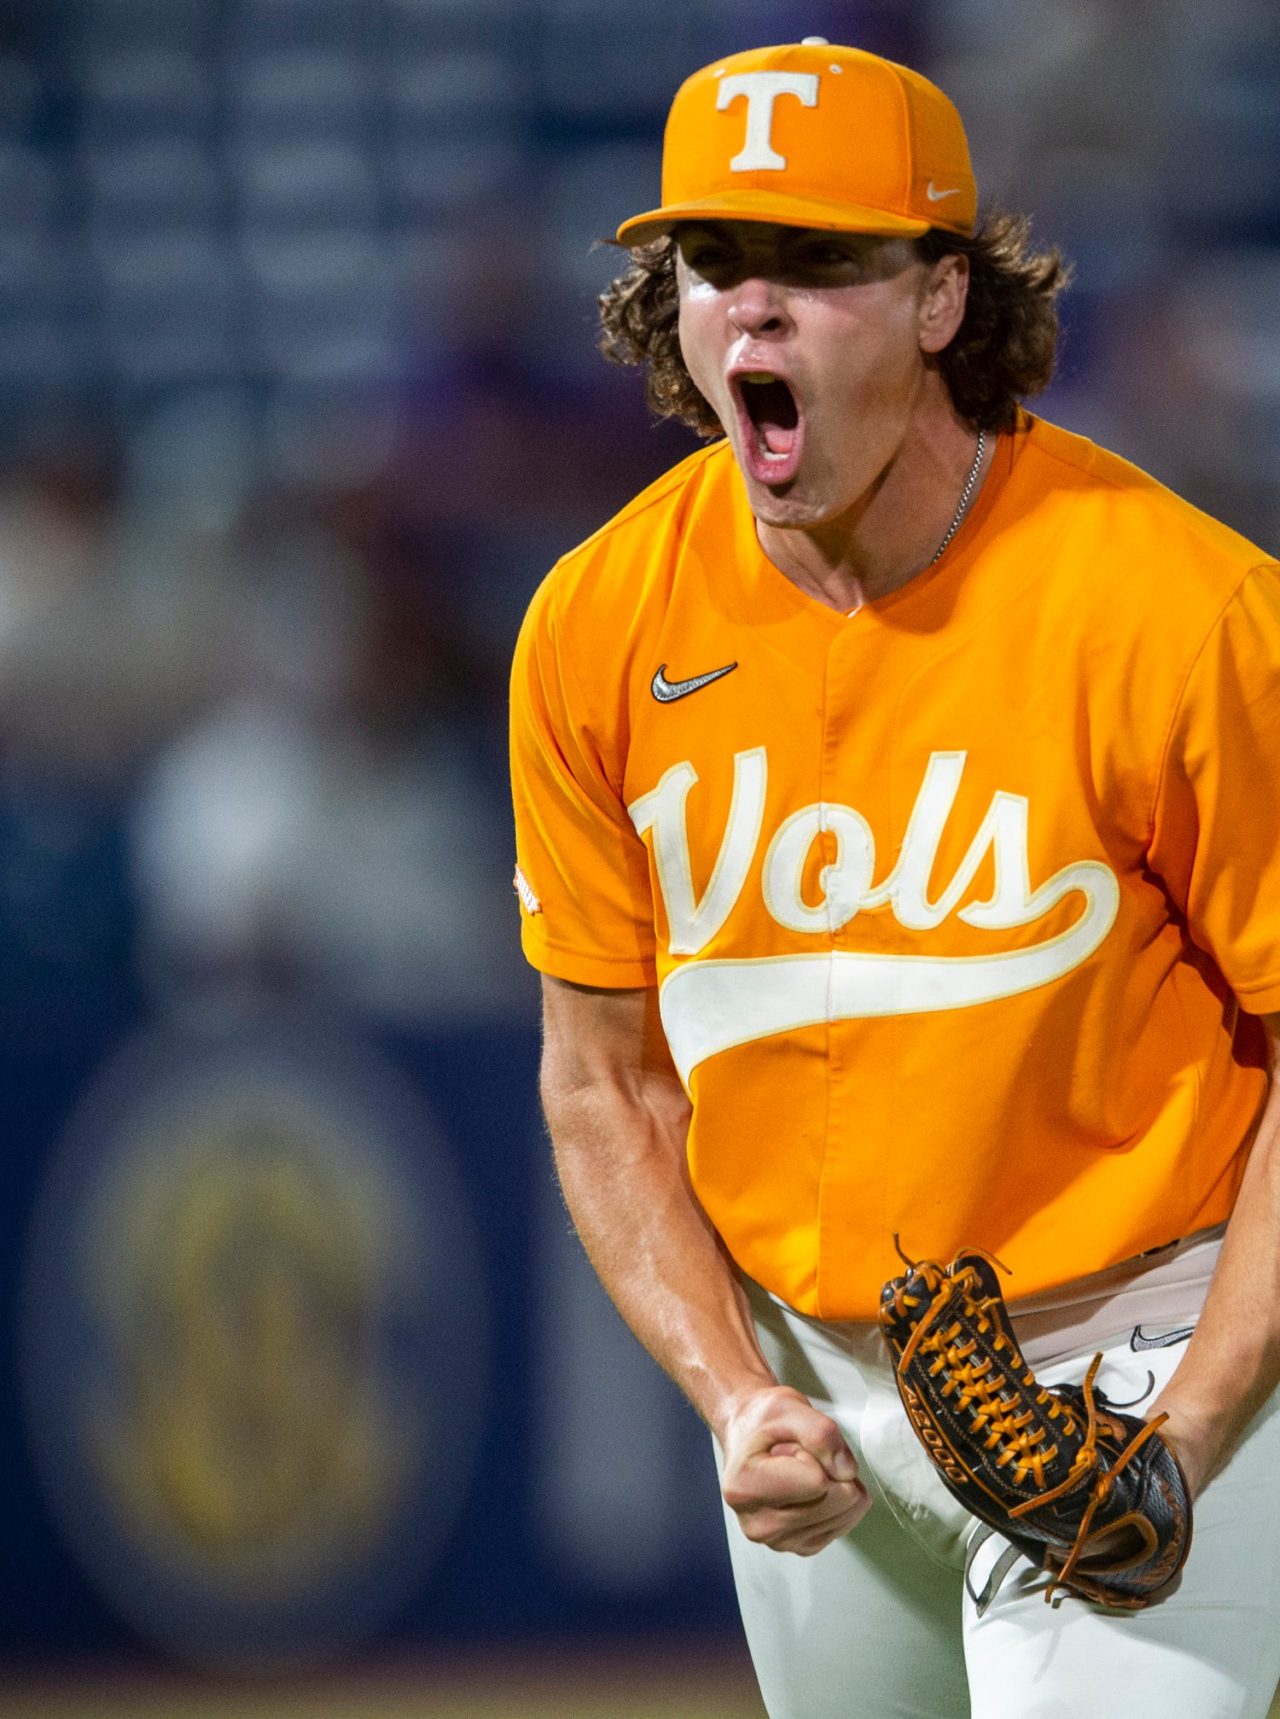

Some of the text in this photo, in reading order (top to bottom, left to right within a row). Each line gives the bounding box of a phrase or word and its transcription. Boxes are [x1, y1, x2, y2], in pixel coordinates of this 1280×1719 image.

[716, 71, 820, 173] T
[628, 745, 1060, 957] Vols
[903, 1384, 969, 1483] A2000
